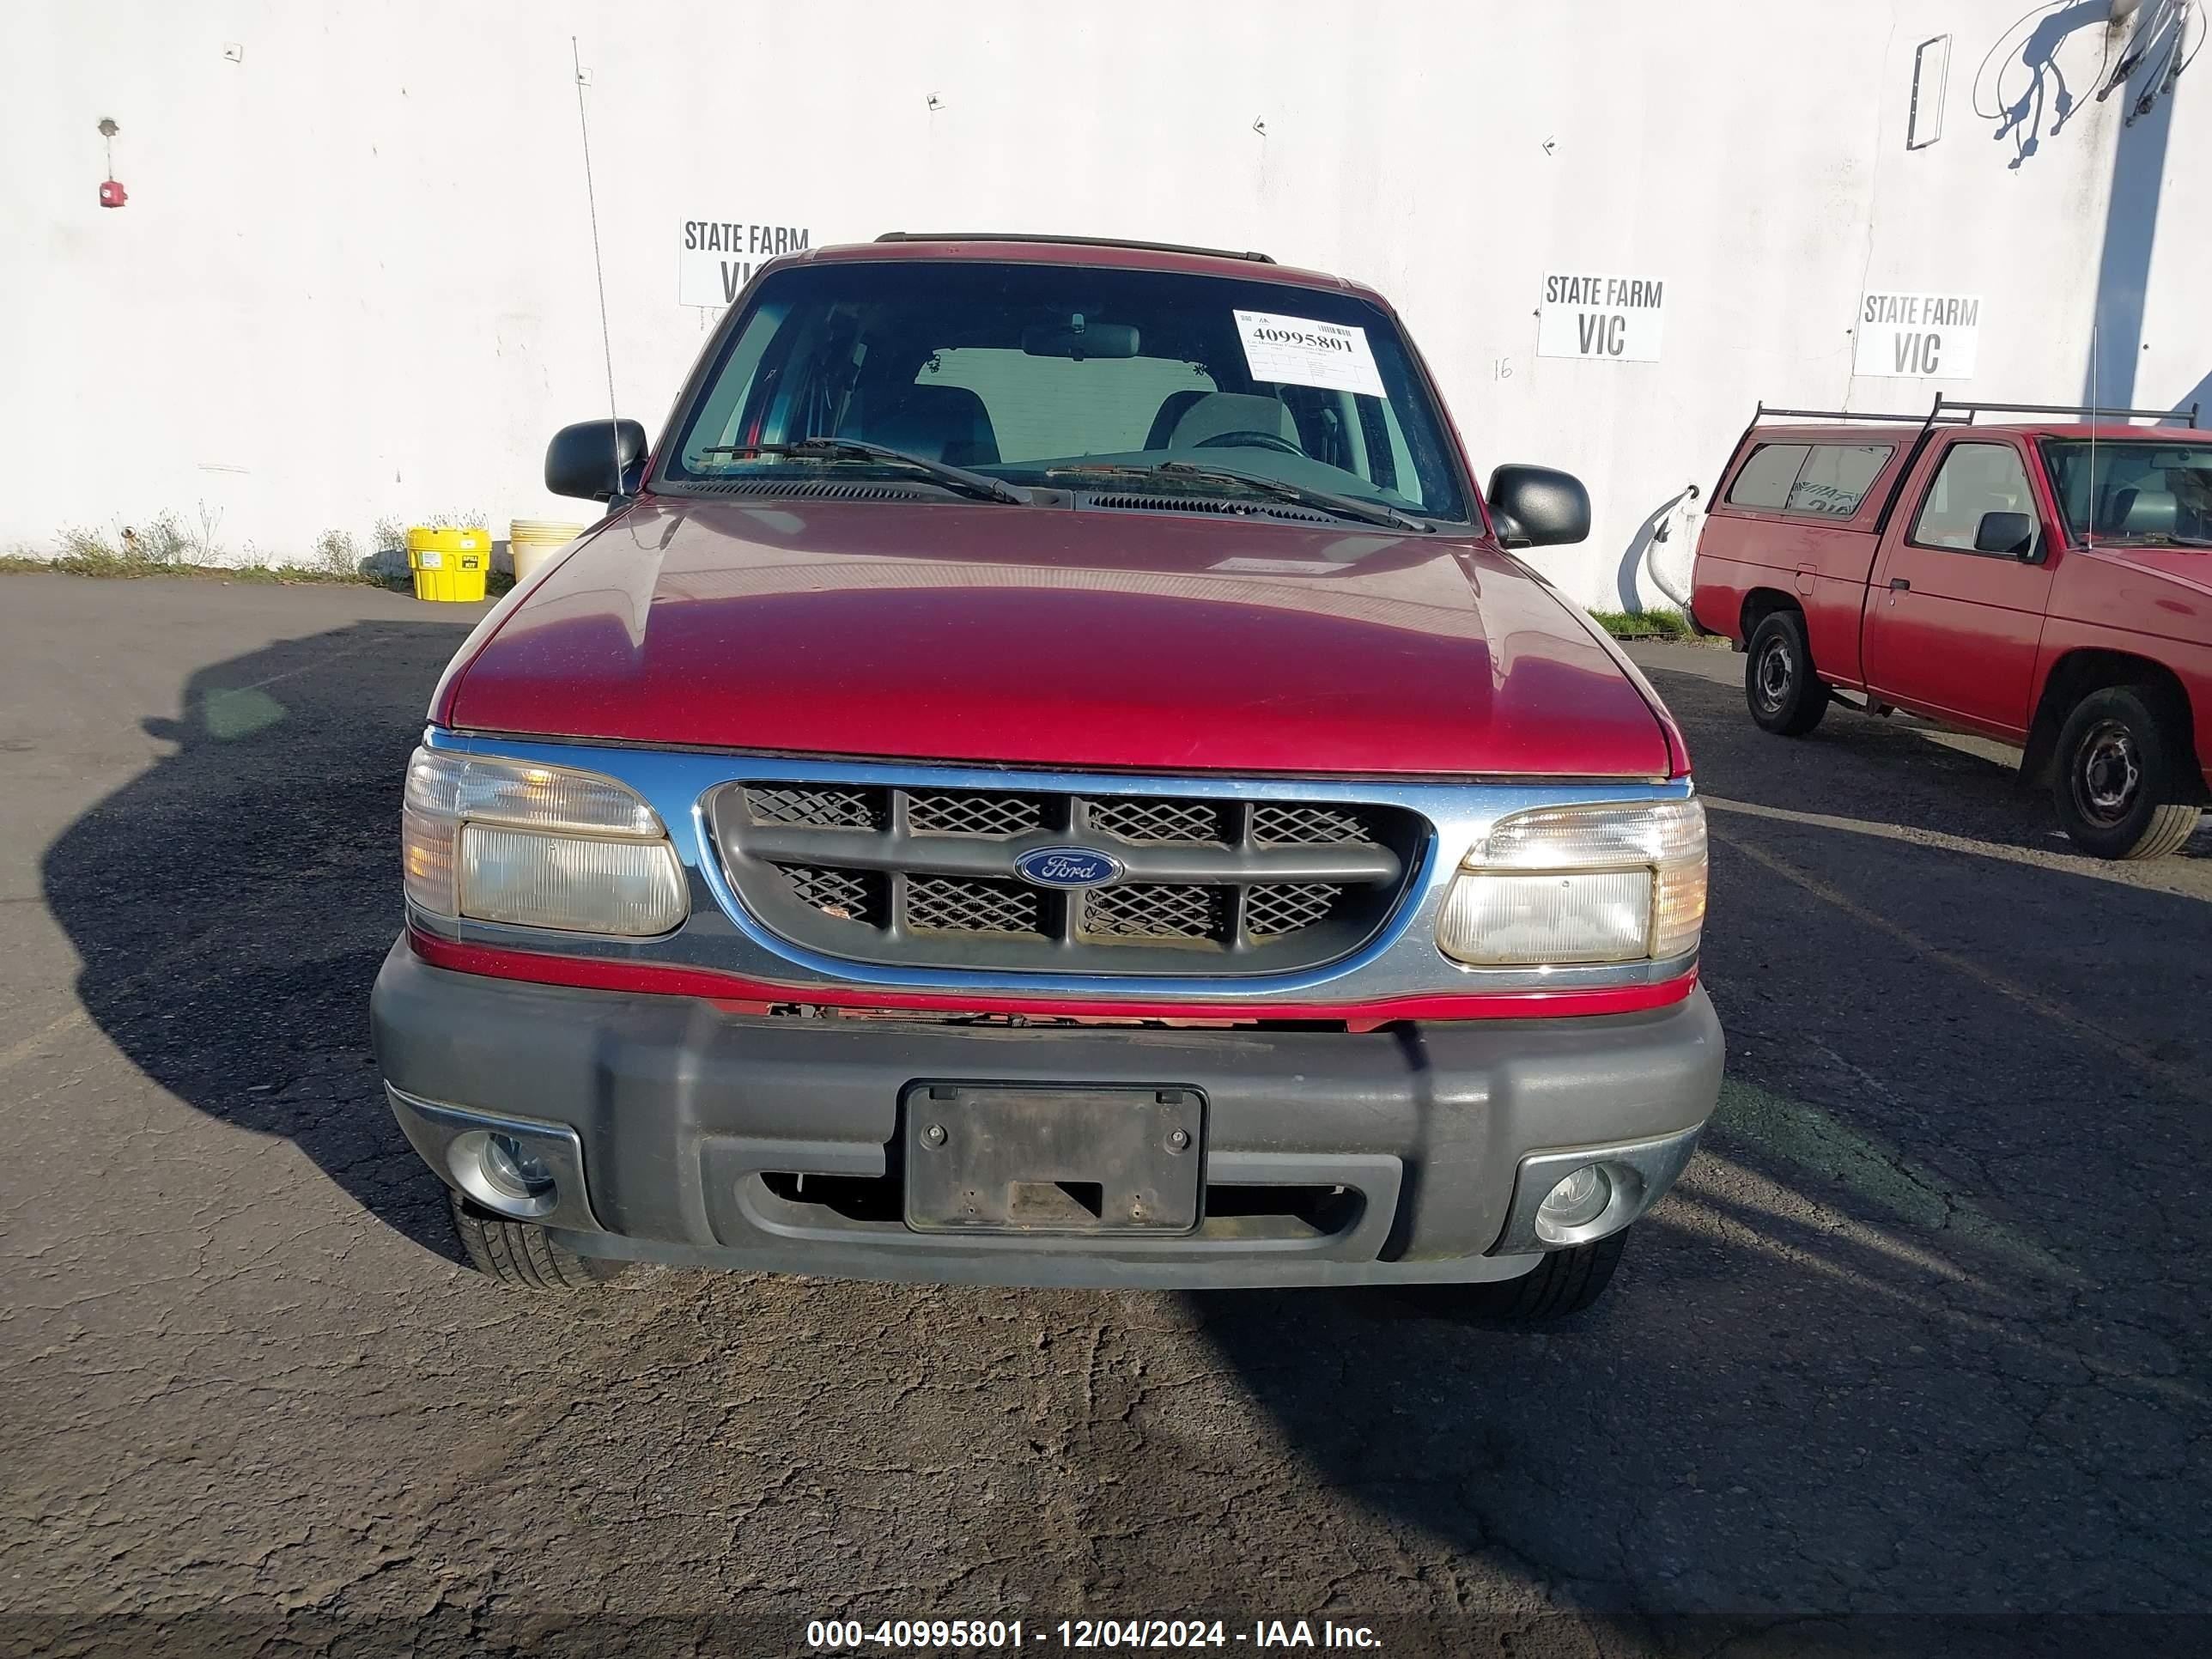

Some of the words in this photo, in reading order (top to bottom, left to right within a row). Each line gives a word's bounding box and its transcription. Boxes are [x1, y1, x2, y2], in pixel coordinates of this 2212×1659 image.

[684, 220, 743, 252] STATE
[749, 225, 809, 255] FARM
[720, 260, 762, 304] VI
[1546, 275, 1602, 306] STATE
[1606, 278, 1663, 309] FARM
[1864, 295, 1919, 325] STATE
[1922, 297, 1979, 326] FARM
[1253, 327, 1354, 353] 40995801
[1578, 313, 1626, 356] VIC
[1494, 357, 1513, 381] 16
[1895, 331, 1942, 374] VIC
[1042, 855, 1097, 878] Ford
